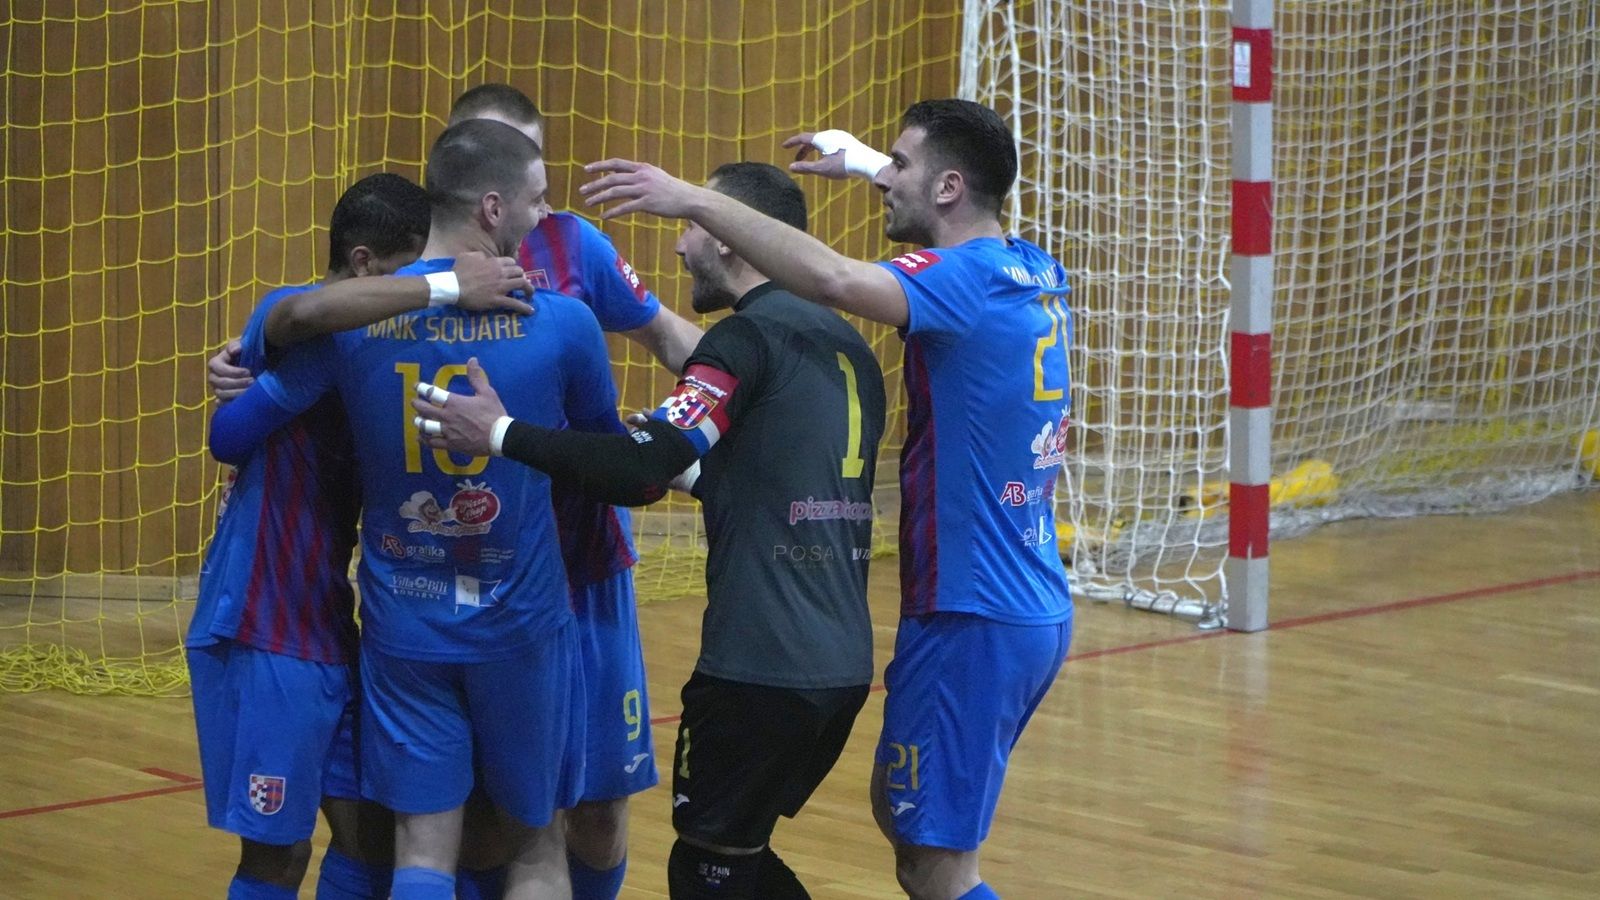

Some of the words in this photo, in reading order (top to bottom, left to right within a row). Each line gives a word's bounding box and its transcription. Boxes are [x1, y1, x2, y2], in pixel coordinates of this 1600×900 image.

[367, 315, 418, 341] MNK
[425, 313, 527, 344] SQUARE
[836, 351, 865, 478] 1
[1000, 481, 1026, 506] AB
[773, 545, 843, 561] POSA
[623, 689, 642, 741] 9
[680, 728, 691, 778] 1
[886, 743, 918, 790] 21
